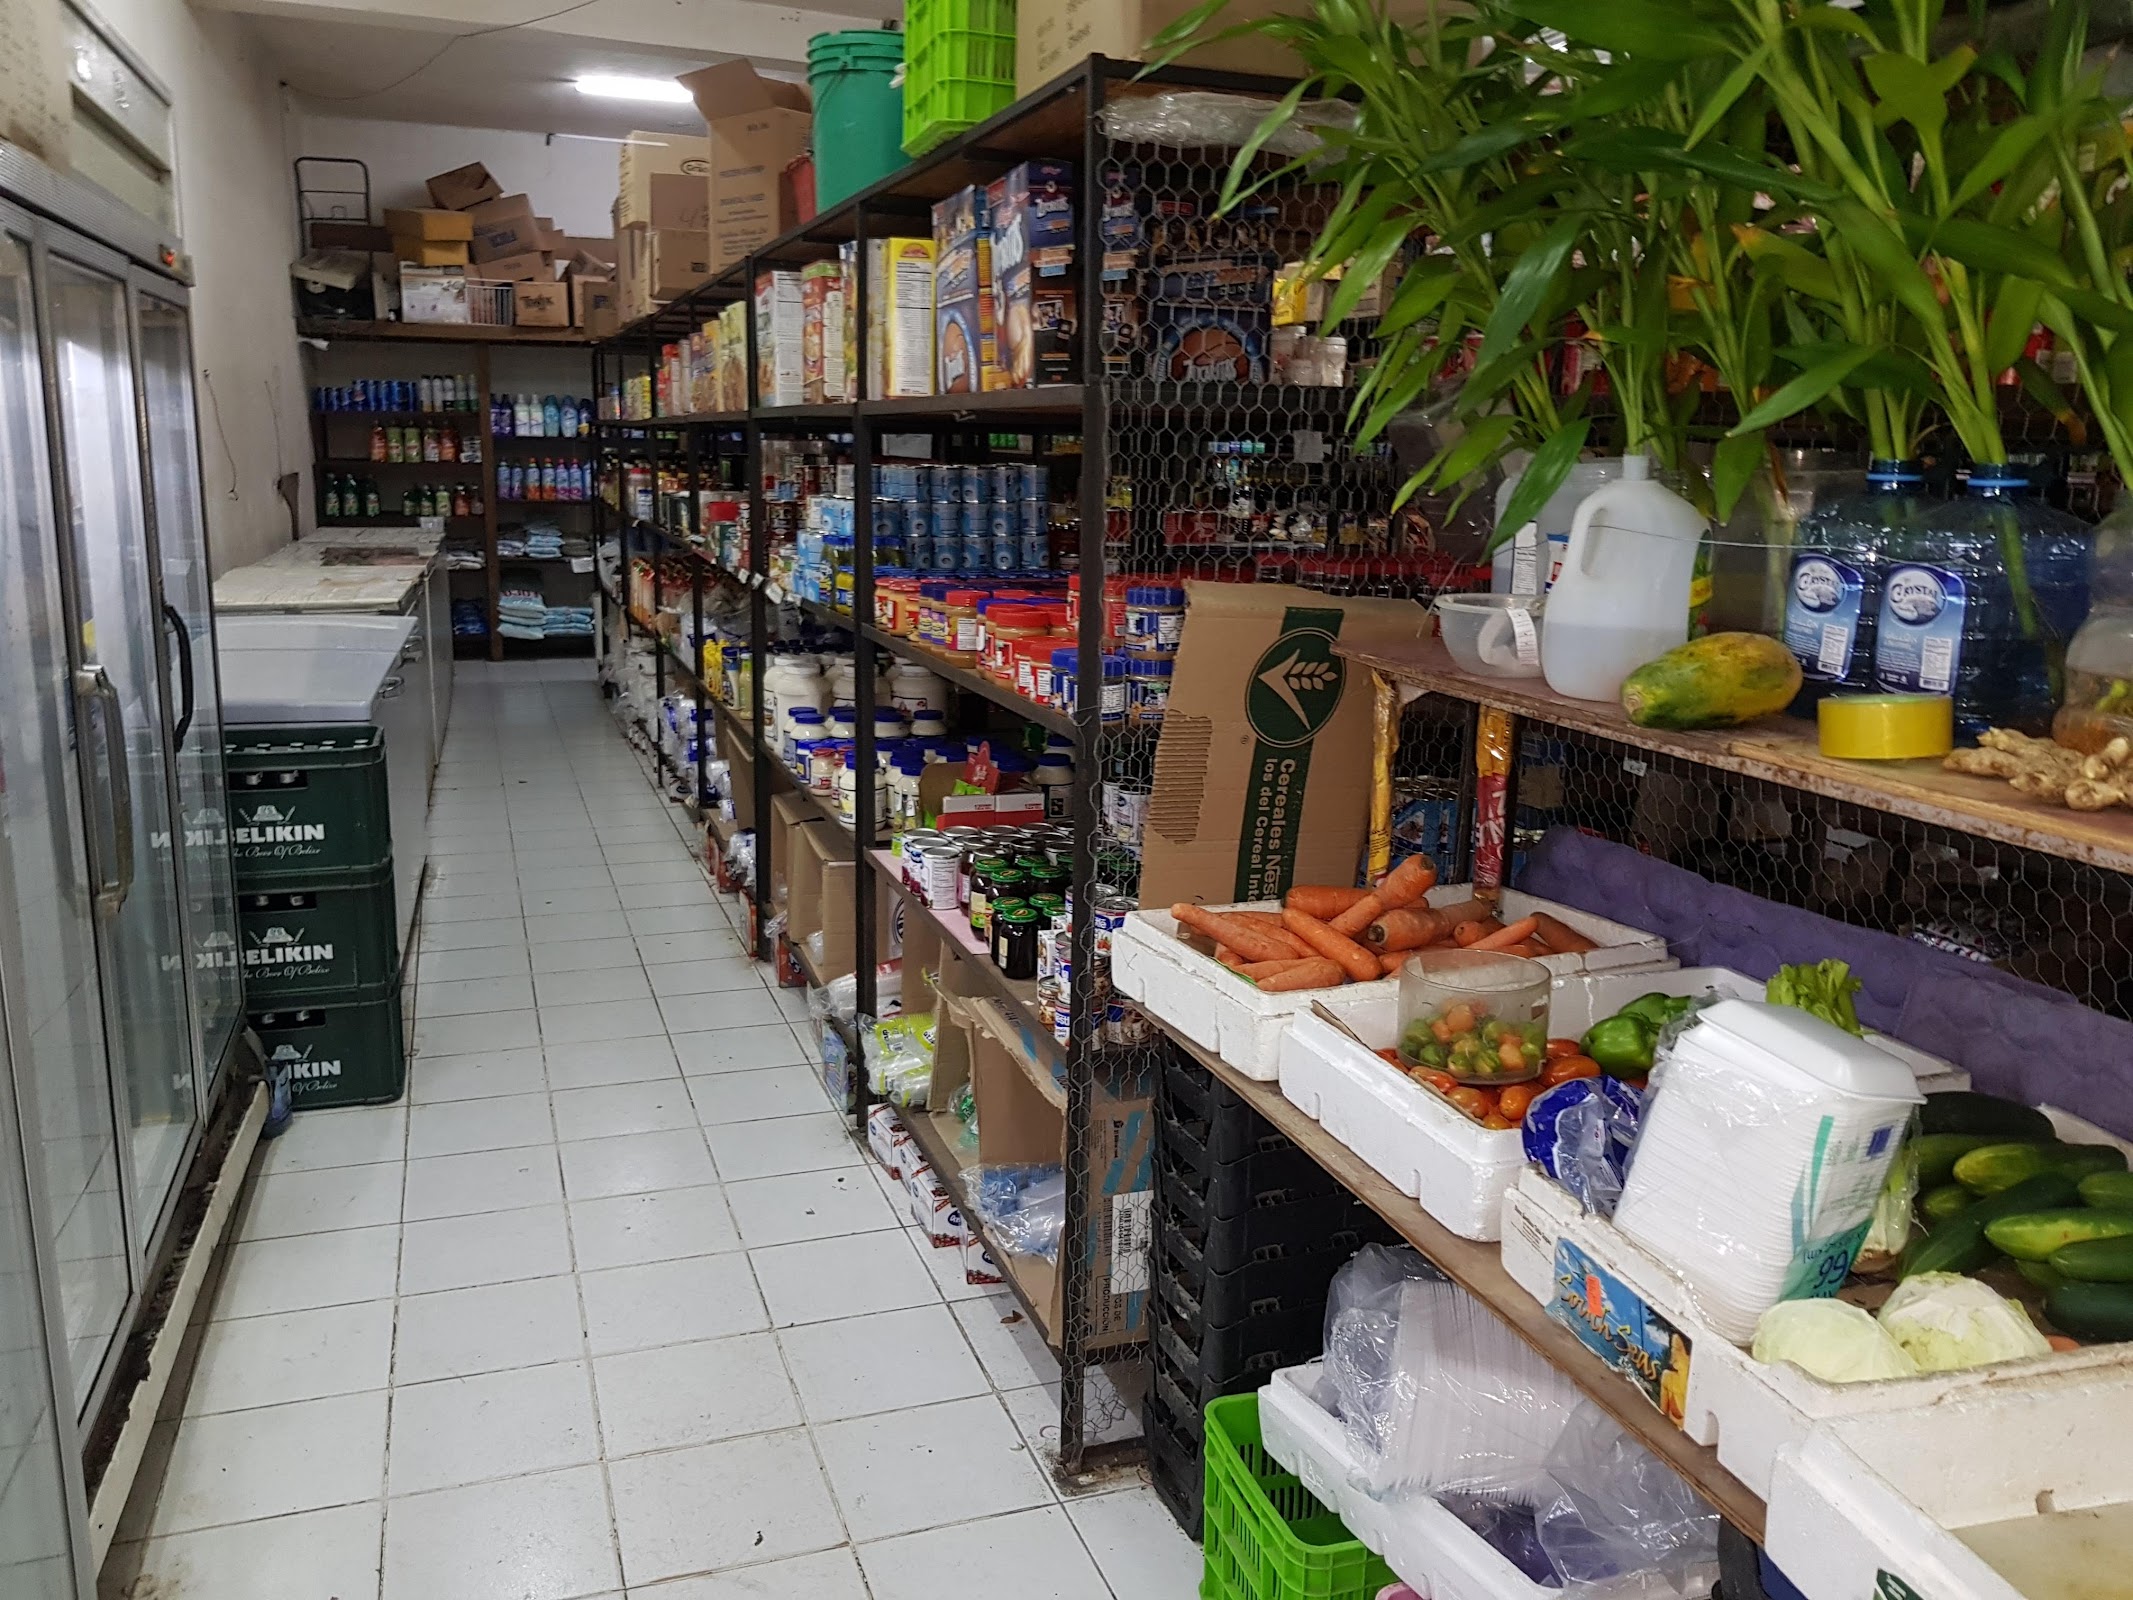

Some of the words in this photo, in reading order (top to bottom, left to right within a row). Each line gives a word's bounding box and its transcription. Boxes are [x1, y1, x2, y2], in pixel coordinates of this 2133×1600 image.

[1263, 758, 1278, 782] los
[1258, 786, 1273, 811] del
[1269, 759, 1296, 849] Cereales
[233, 824, 325, 843] ELIKIN
[1251, 816, 1268, 868] Cereal
[243, 945, 334, 965] ELIKIN
[1813, 1249, 1850, 1289] 99
